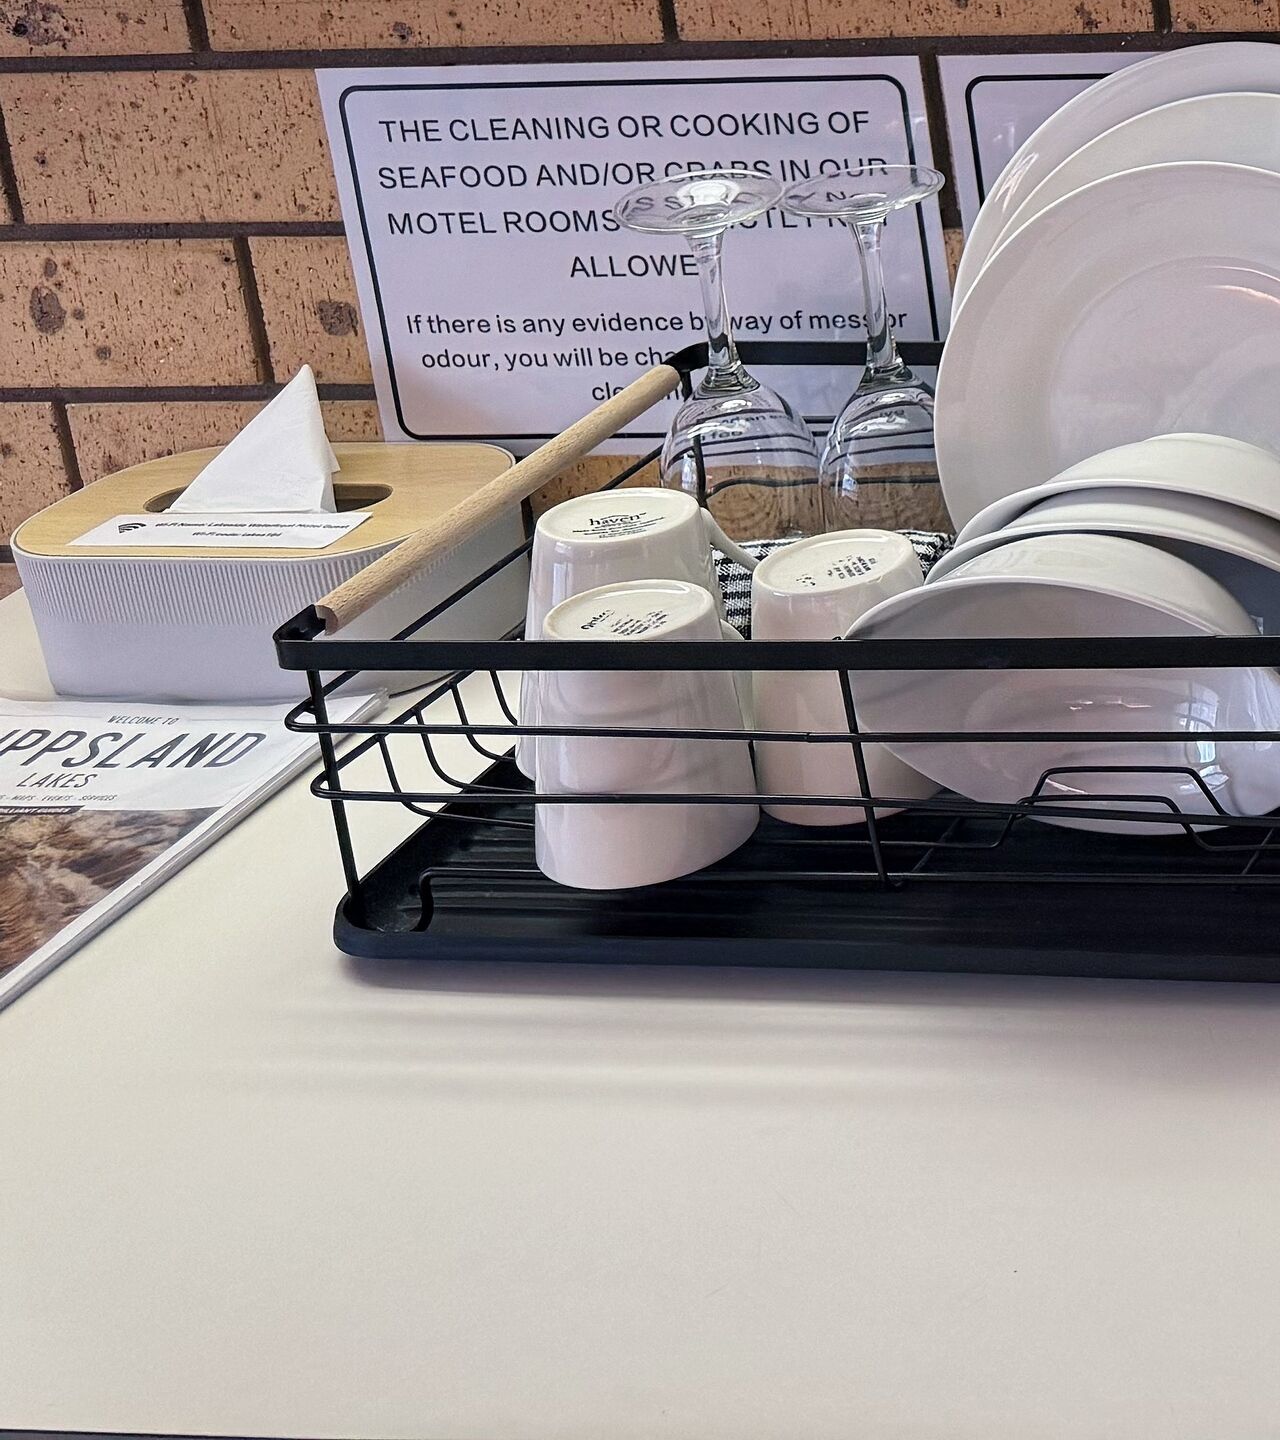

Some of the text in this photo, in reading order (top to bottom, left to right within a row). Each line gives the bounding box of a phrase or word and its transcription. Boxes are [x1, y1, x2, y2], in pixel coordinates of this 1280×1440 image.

[378, 111, 869, 142] THE CLEANING OR COOKING OF
[378, 165, 527, 189] SEAFOOD
[536, 162, 656, 187] AND/OR
[781, 159, 810, 182] IN
[820, 158, 889, 178] OUR
[388, 210, 621, 234] MOTEL ROOMS
[571, 254, 699, 278] ALLOWE
[407, 315, 421, 334] If
[427, 315, 491, 334] there
[496, 315, 516, 334] is
[523, 318, 564, 336] any
[572, 312, 683, 333] evidence
[689, 311, 706, 331] b
[779, 310, 802, 330] of
[504, 352, 548, 371] you
[553, 347, 593, 367] will
[599, 347, 628, 366] be
[107, 715, 180, 725] WELCOME TO
[16, 772, 98, 788] LAKES
